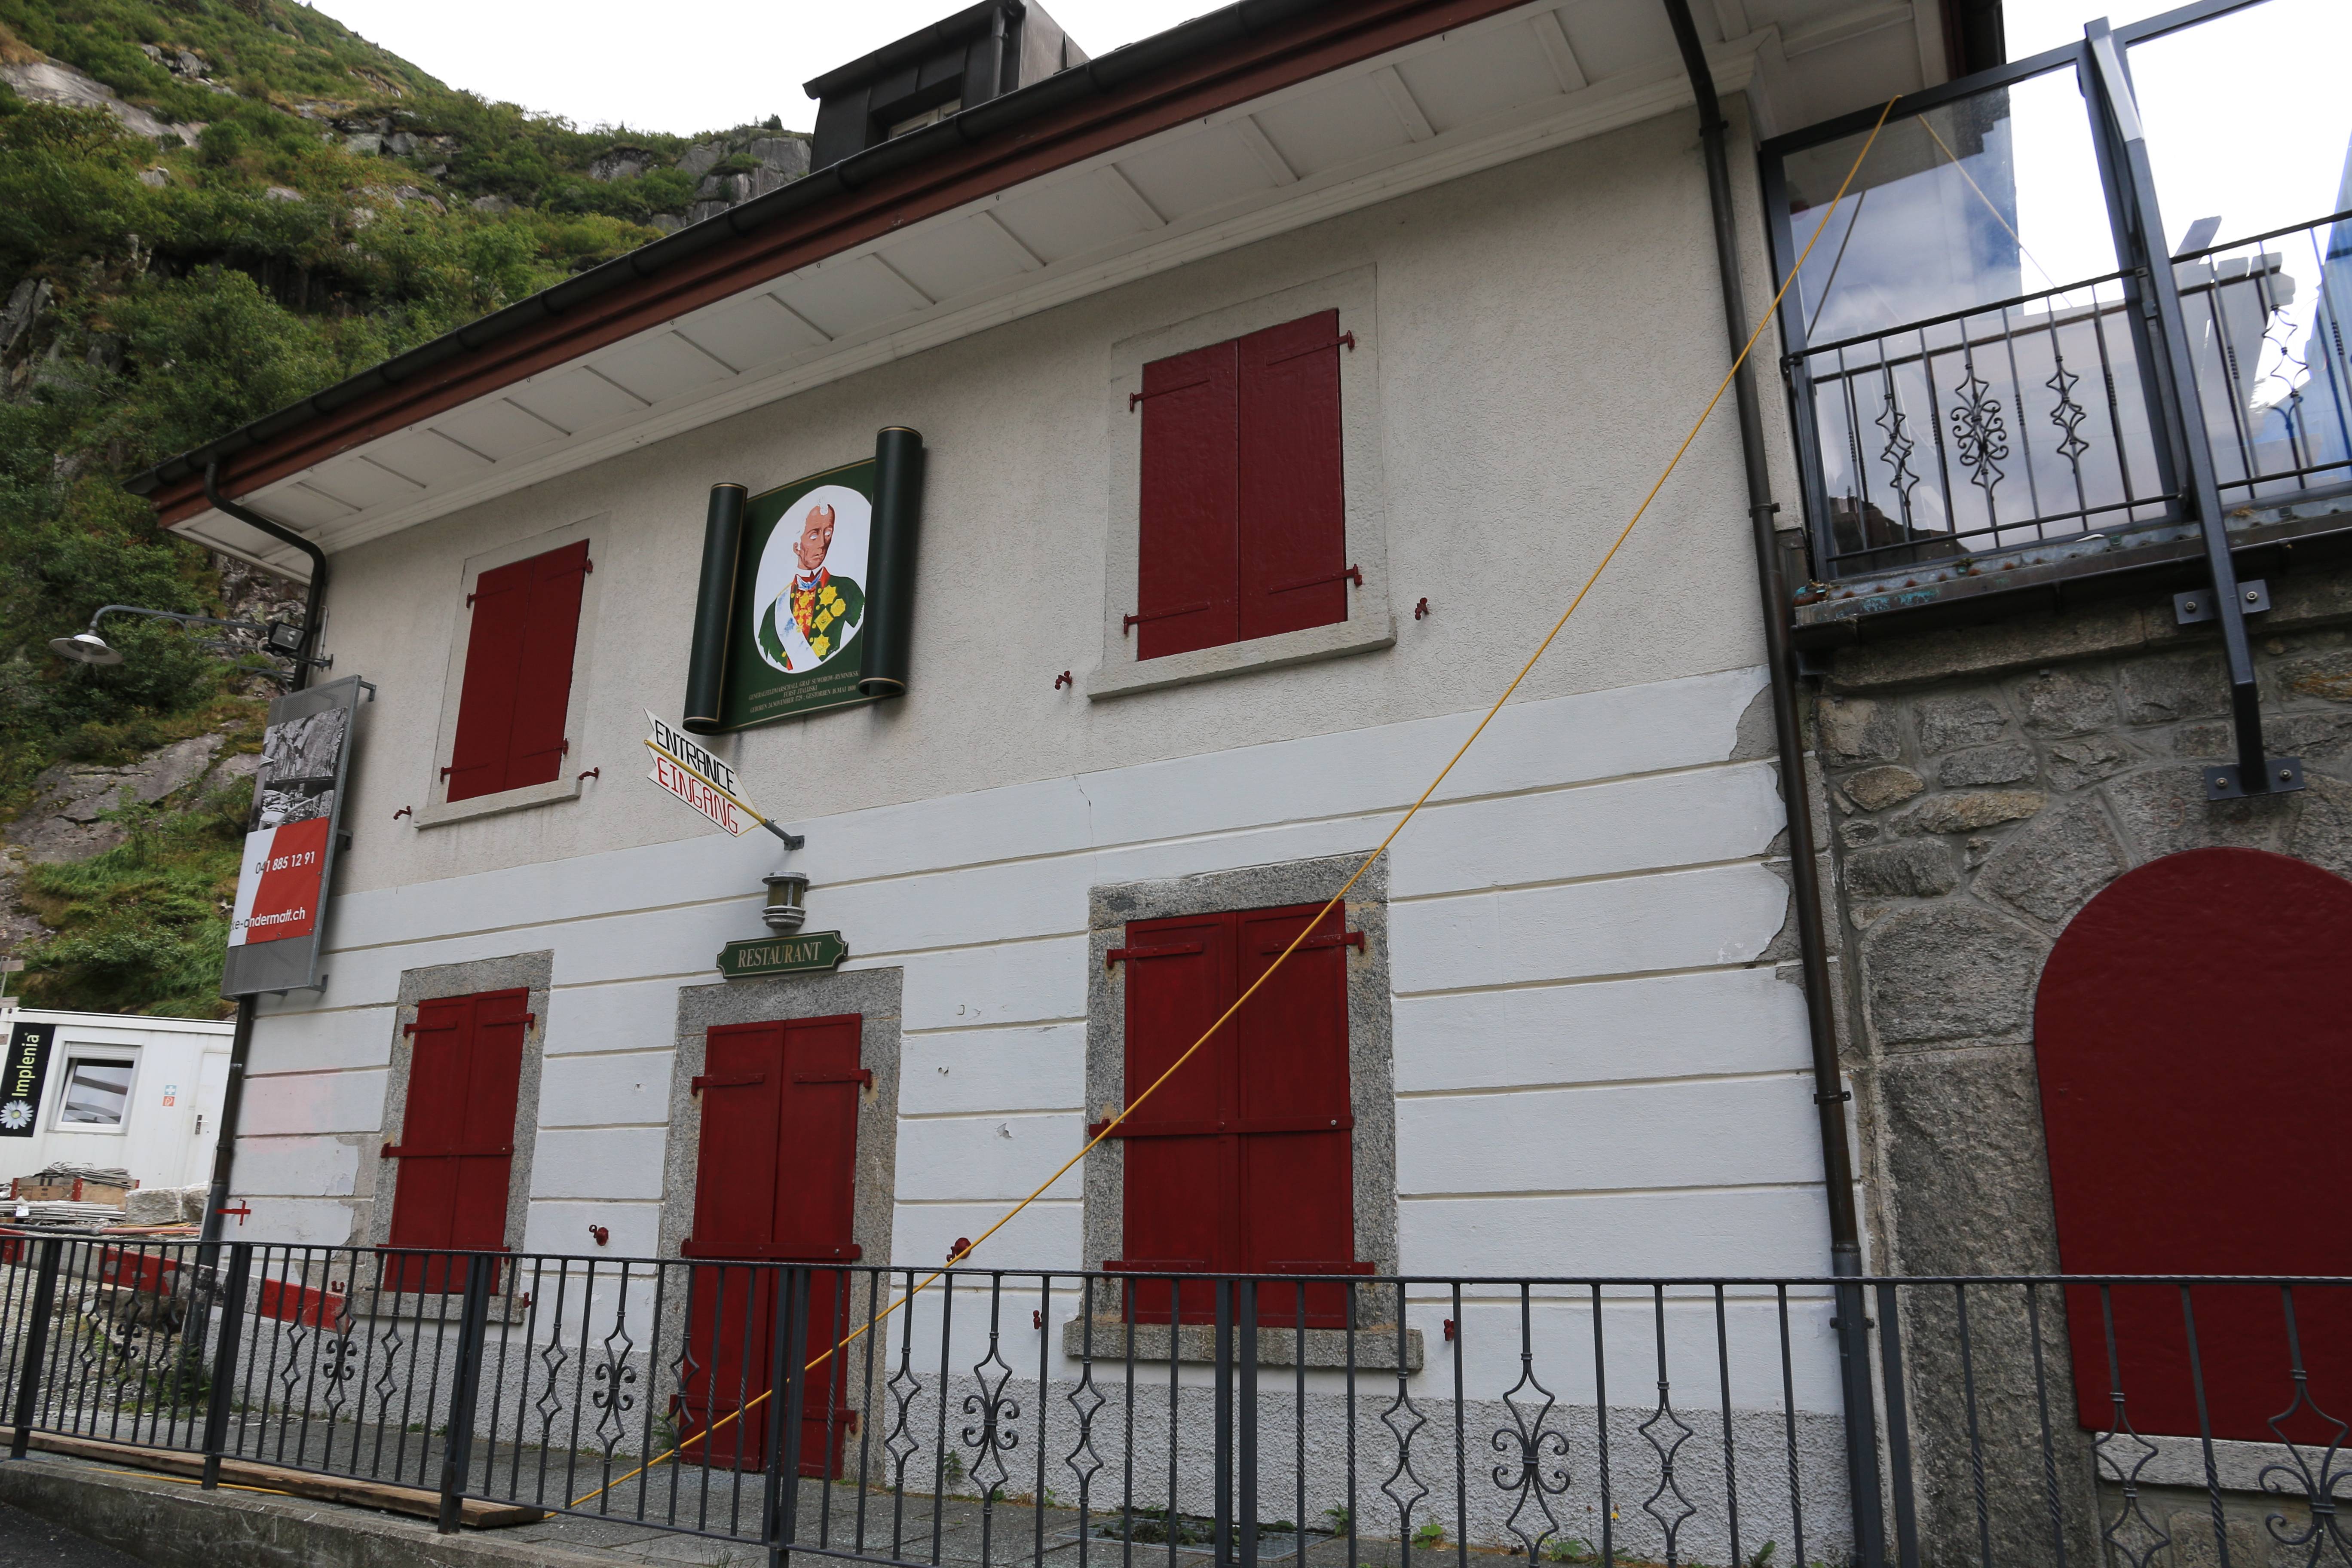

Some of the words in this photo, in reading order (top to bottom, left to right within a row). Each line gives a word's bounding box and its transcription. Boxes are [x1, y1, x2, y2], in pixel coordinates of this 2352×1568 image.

[806, 689, 830, 699] GESTORBEN
[655, 720, 736, 796] ENTRANCE
[657, 757, 738, 834] EINGANG
[255, 860, 270, 874] 041
[272, 856, 289, 871] 885
[291, 854, 302, 867] 12
[304, 851, 315, 865] 91
[738, 942, 821, 968] RESTAURANT
[12, 1035, 40, 1096] Implenia
